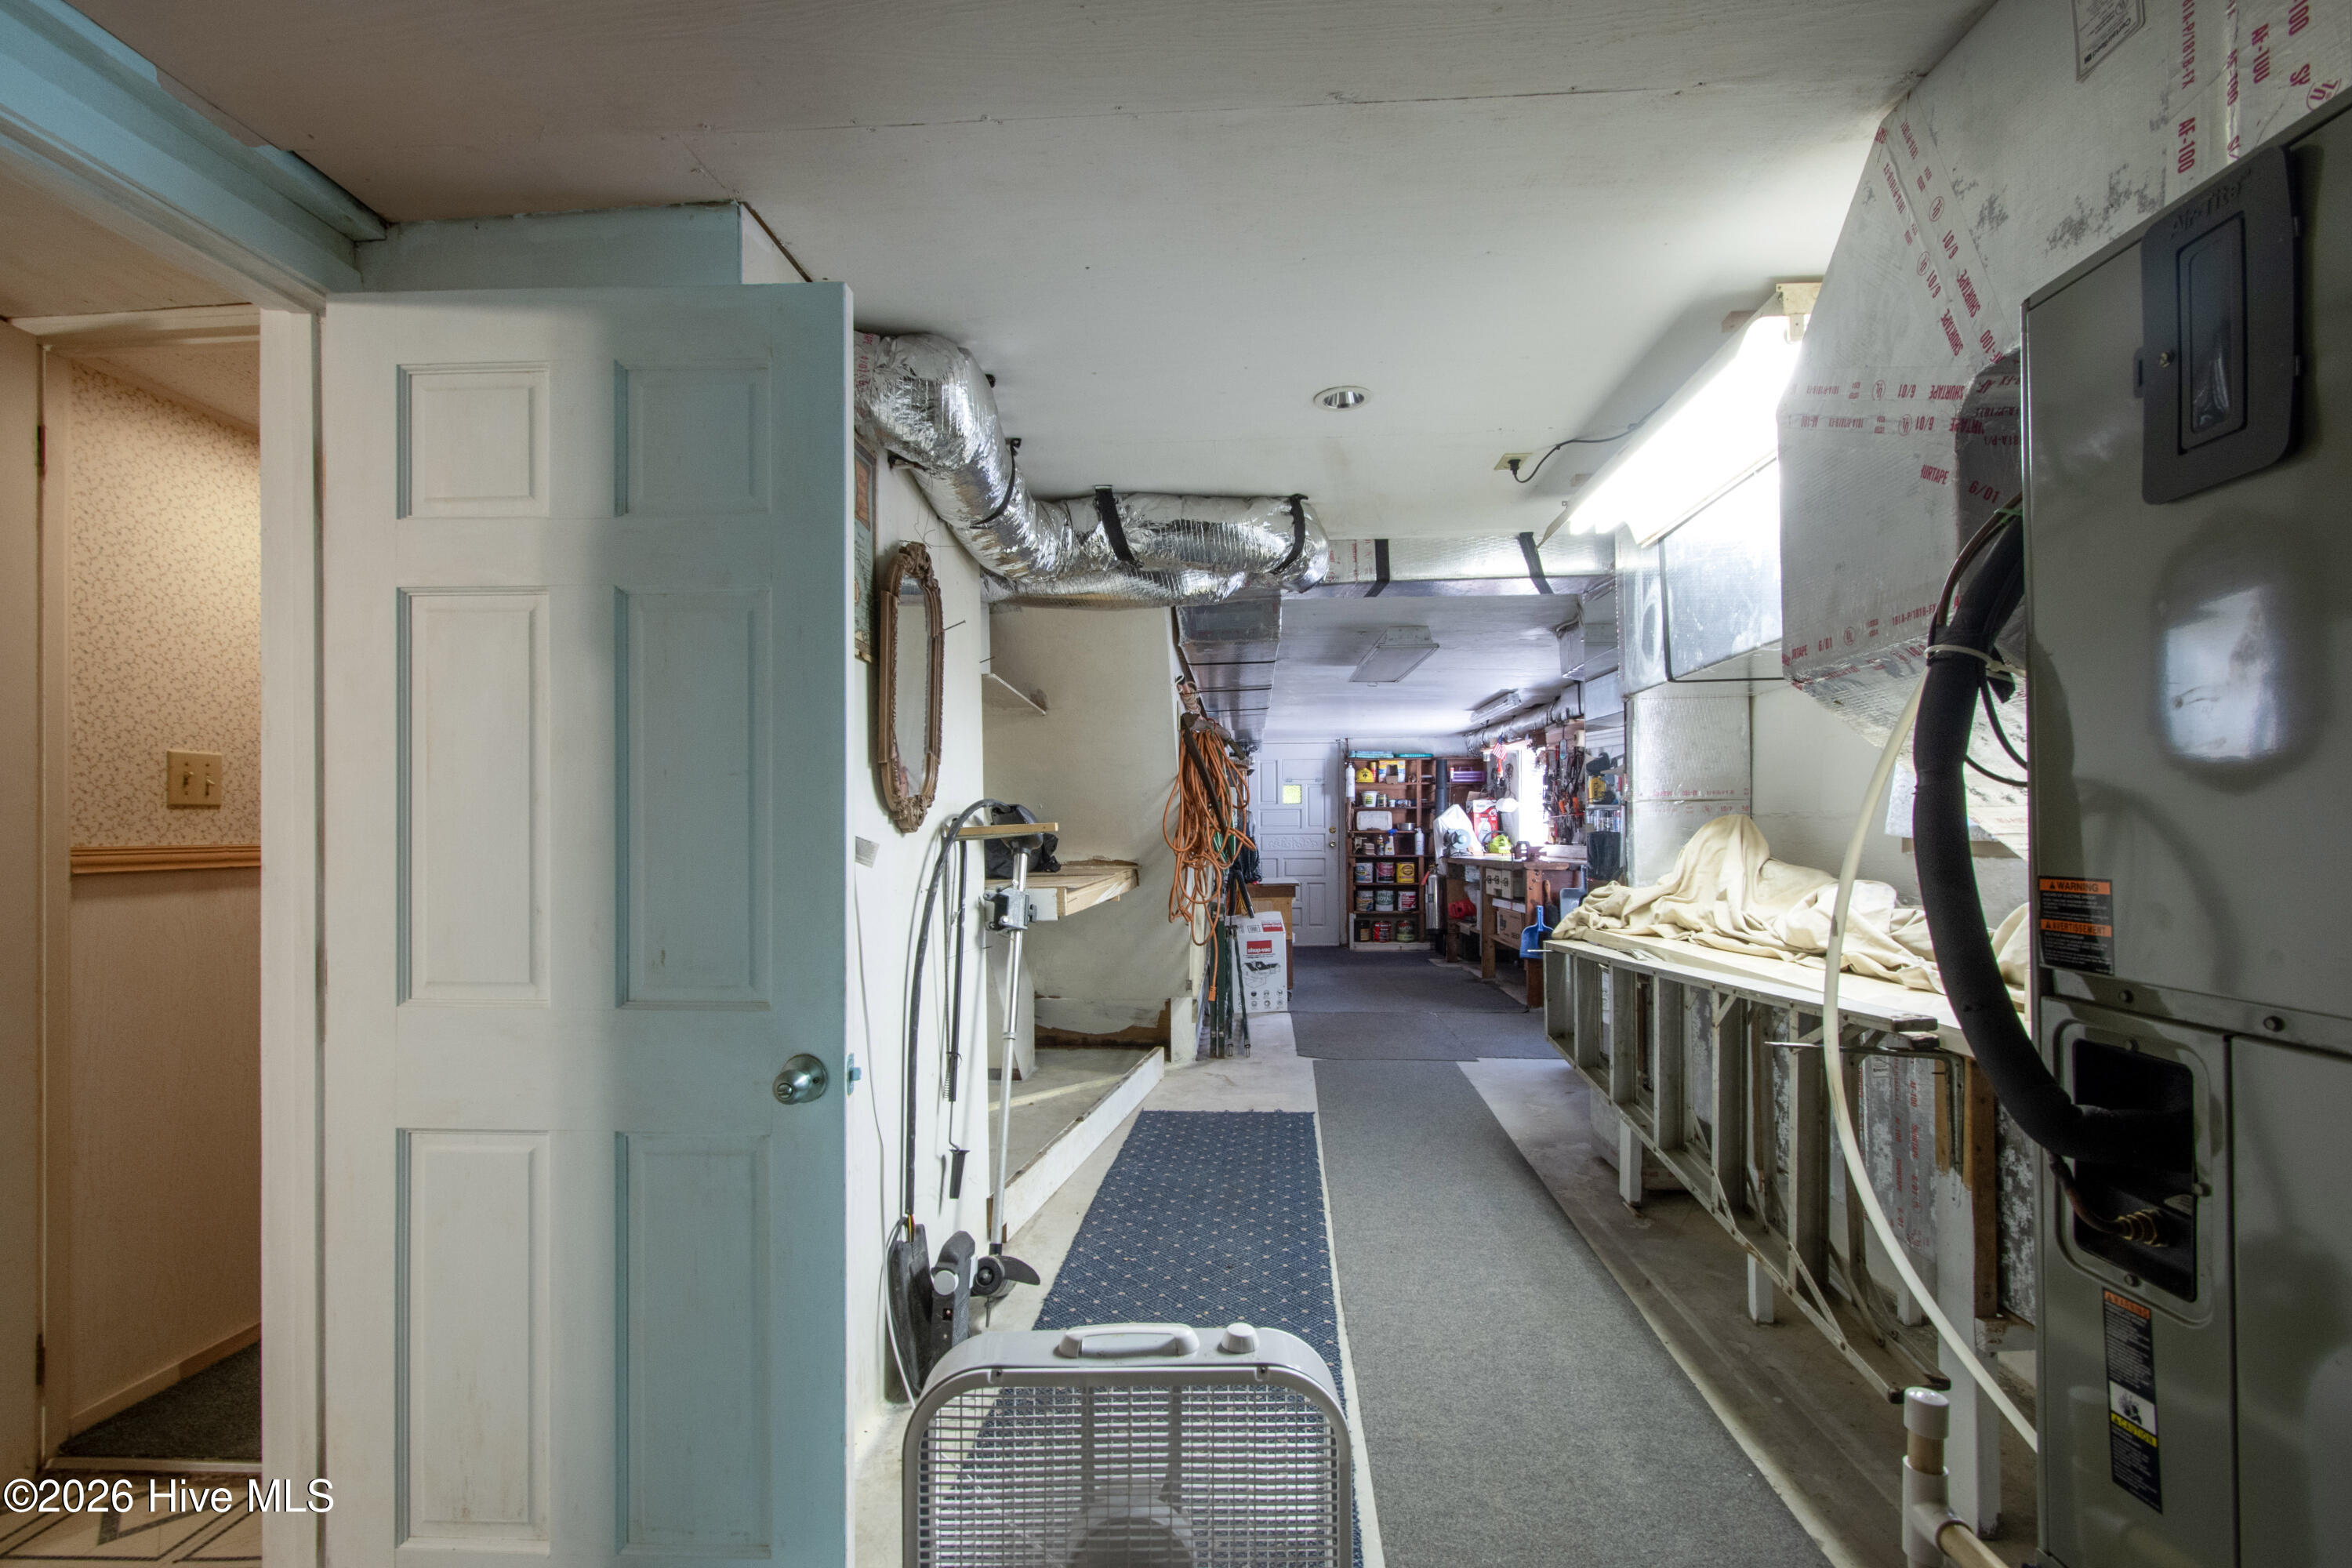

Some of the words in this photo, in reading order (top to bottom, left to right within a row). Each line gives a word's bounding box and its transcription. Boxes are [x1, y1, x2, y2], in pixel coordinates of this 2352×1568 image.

[2178, 117, 2196, 174] AF-100
[1942, 230, 1958, 260] 6/01
[1956, 269, 1981, 318] SHURTAPE
[1926, 269, 1942, 299] 6/01
[1940, 308, 1964, 357] SHURTAPE
[1897, 384, 1917, 398] 6/01
[1929, 385, 1965, 401] SHURTAPE
[1915, 416, 1935, 431] 6/01
[1969, 480, 2000, 504] 6/01
[2056, 881, 2100, 893] WARNING
[2053, 921, 2107, 936] AVERTISSEMENT
